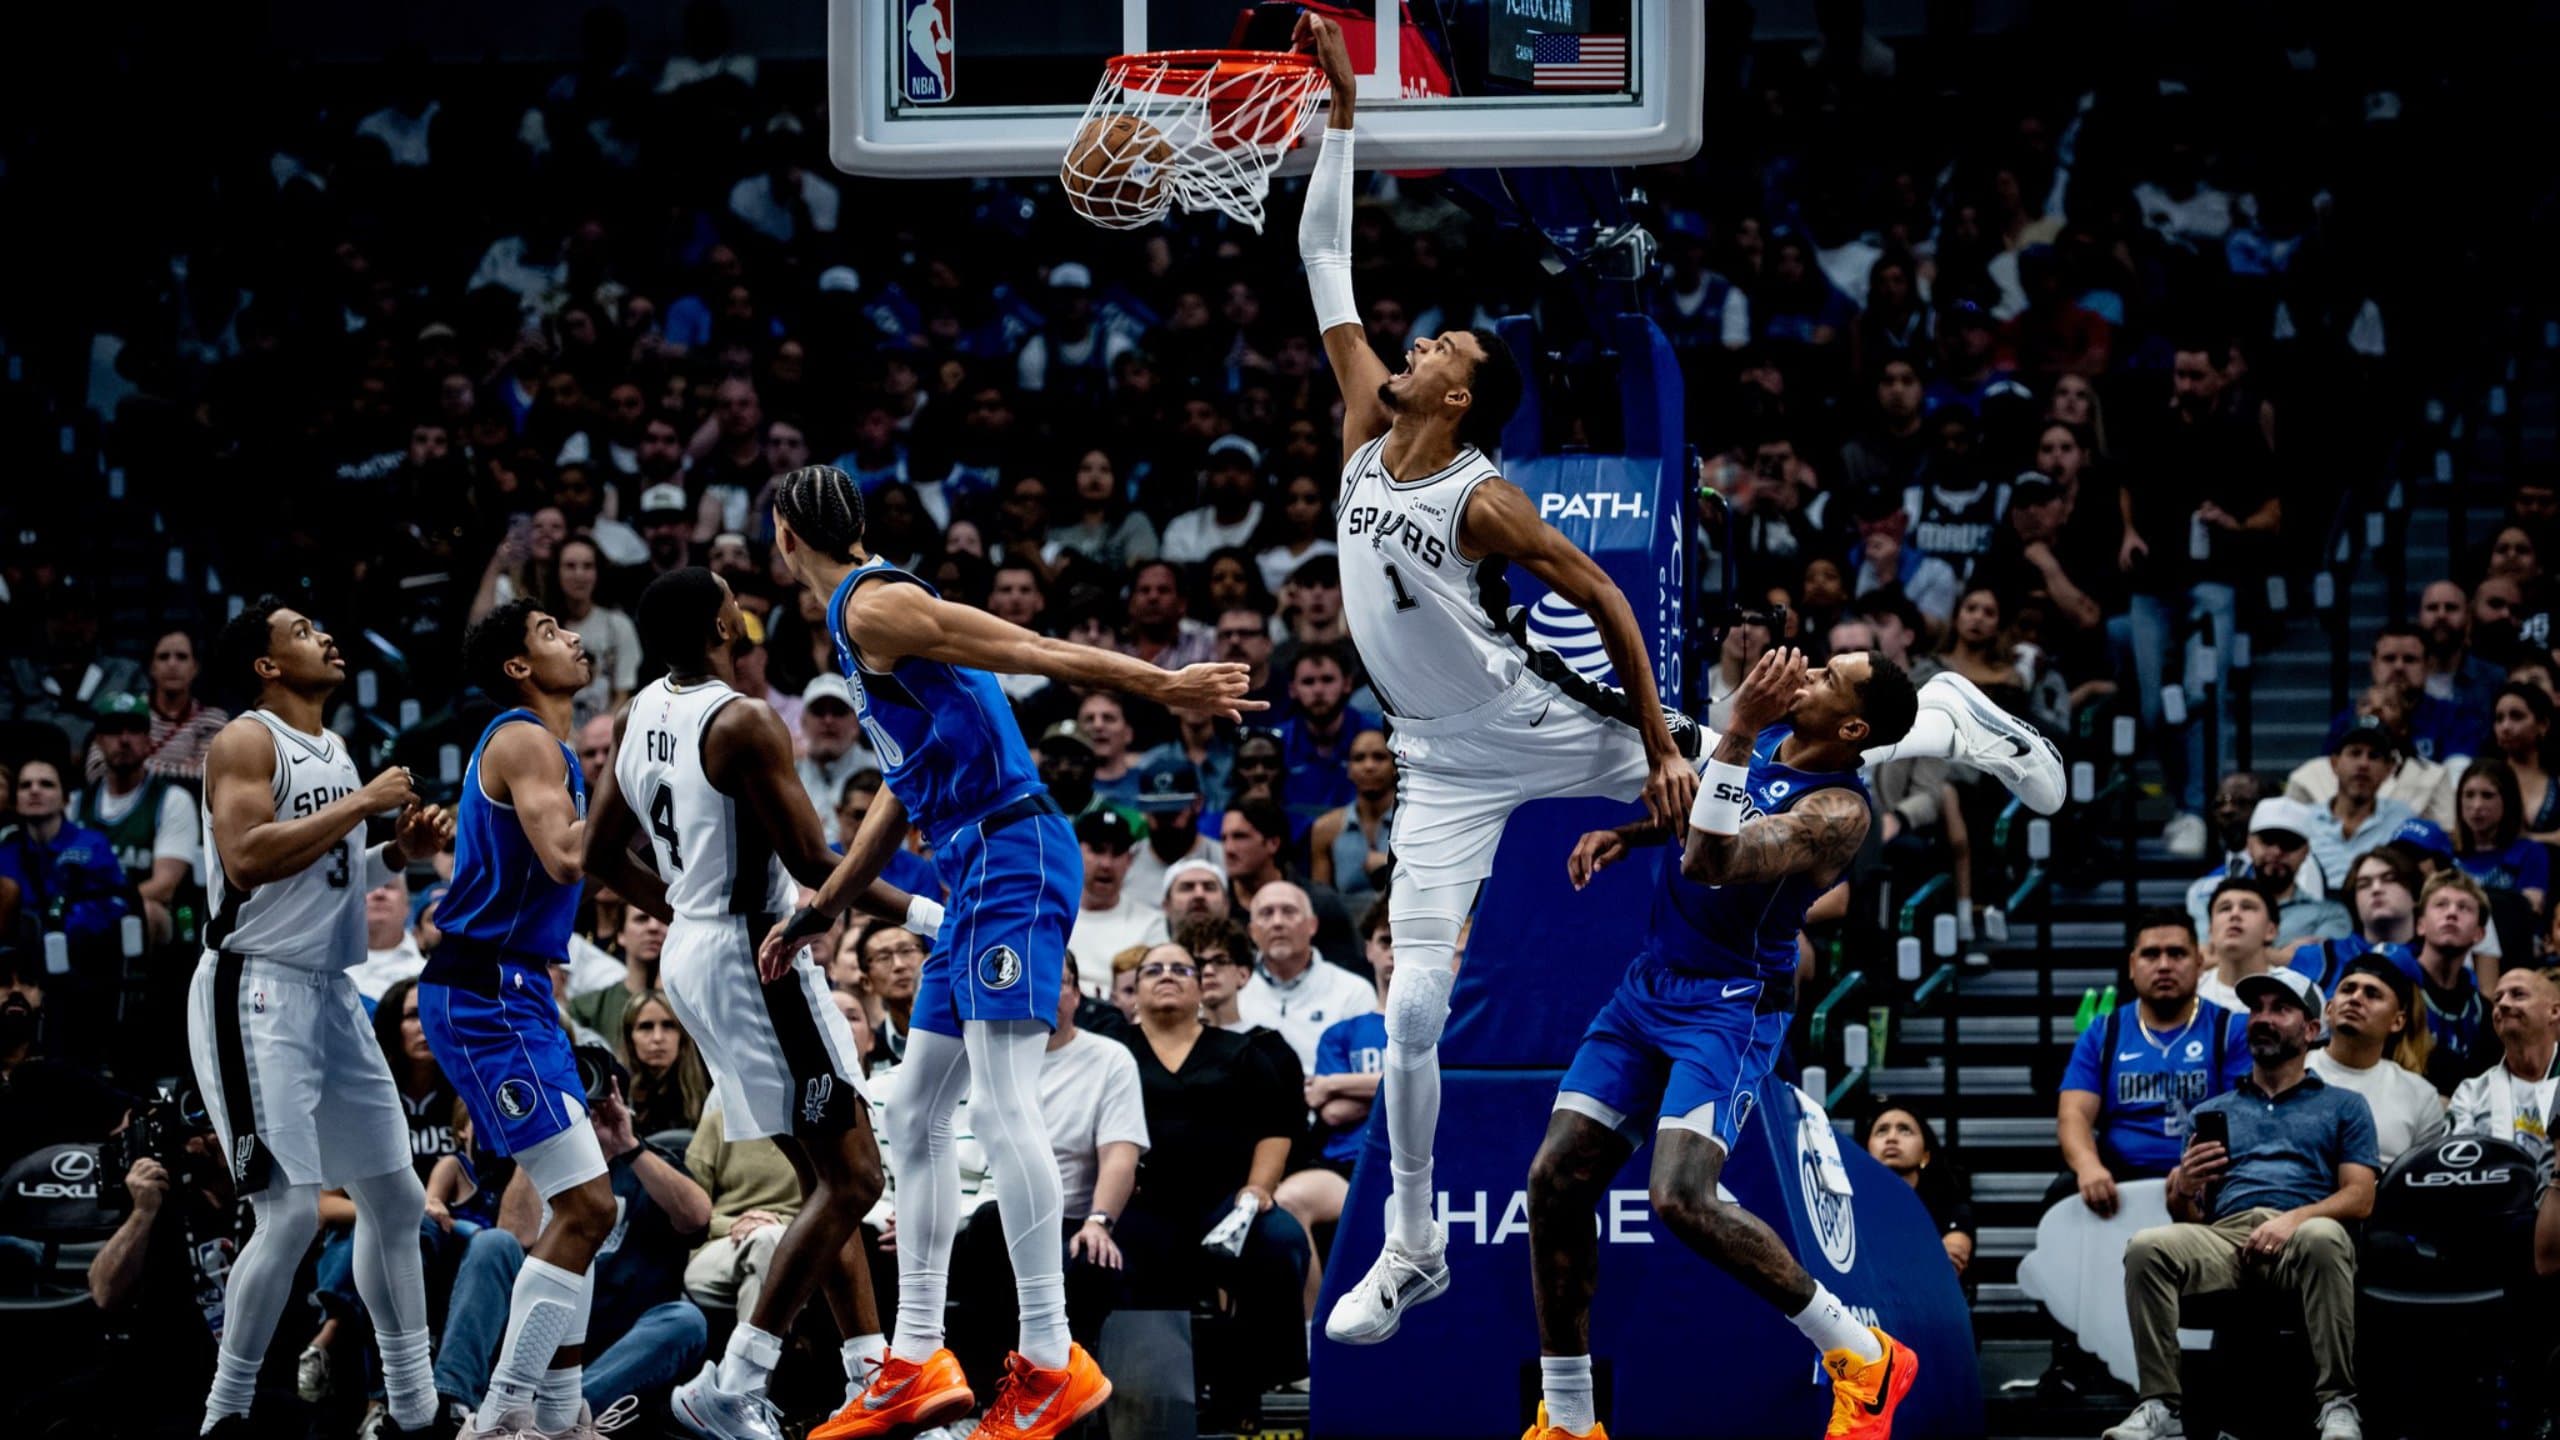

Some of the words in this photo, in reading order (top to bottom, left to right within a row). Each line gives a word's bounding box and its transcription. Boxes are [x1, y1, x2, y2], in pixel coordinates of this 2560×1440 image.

[912, 76, 936, 95] NBA
[1349, 507, 1445, 568] SPURS
[1385, 564, 1419, 613] 1
[1659, 565, 1667, 699] CASINOS
[647, 730, 677, 767] FOX
[649, 778, 684, 873] 4
[327, 840, 349, 889] 3
[17, 1181, 98, 1199] LEXU
[2404, 1168, 2512, 1188] LEXUS
[1384, 1189, 1656, 1245] HAE
